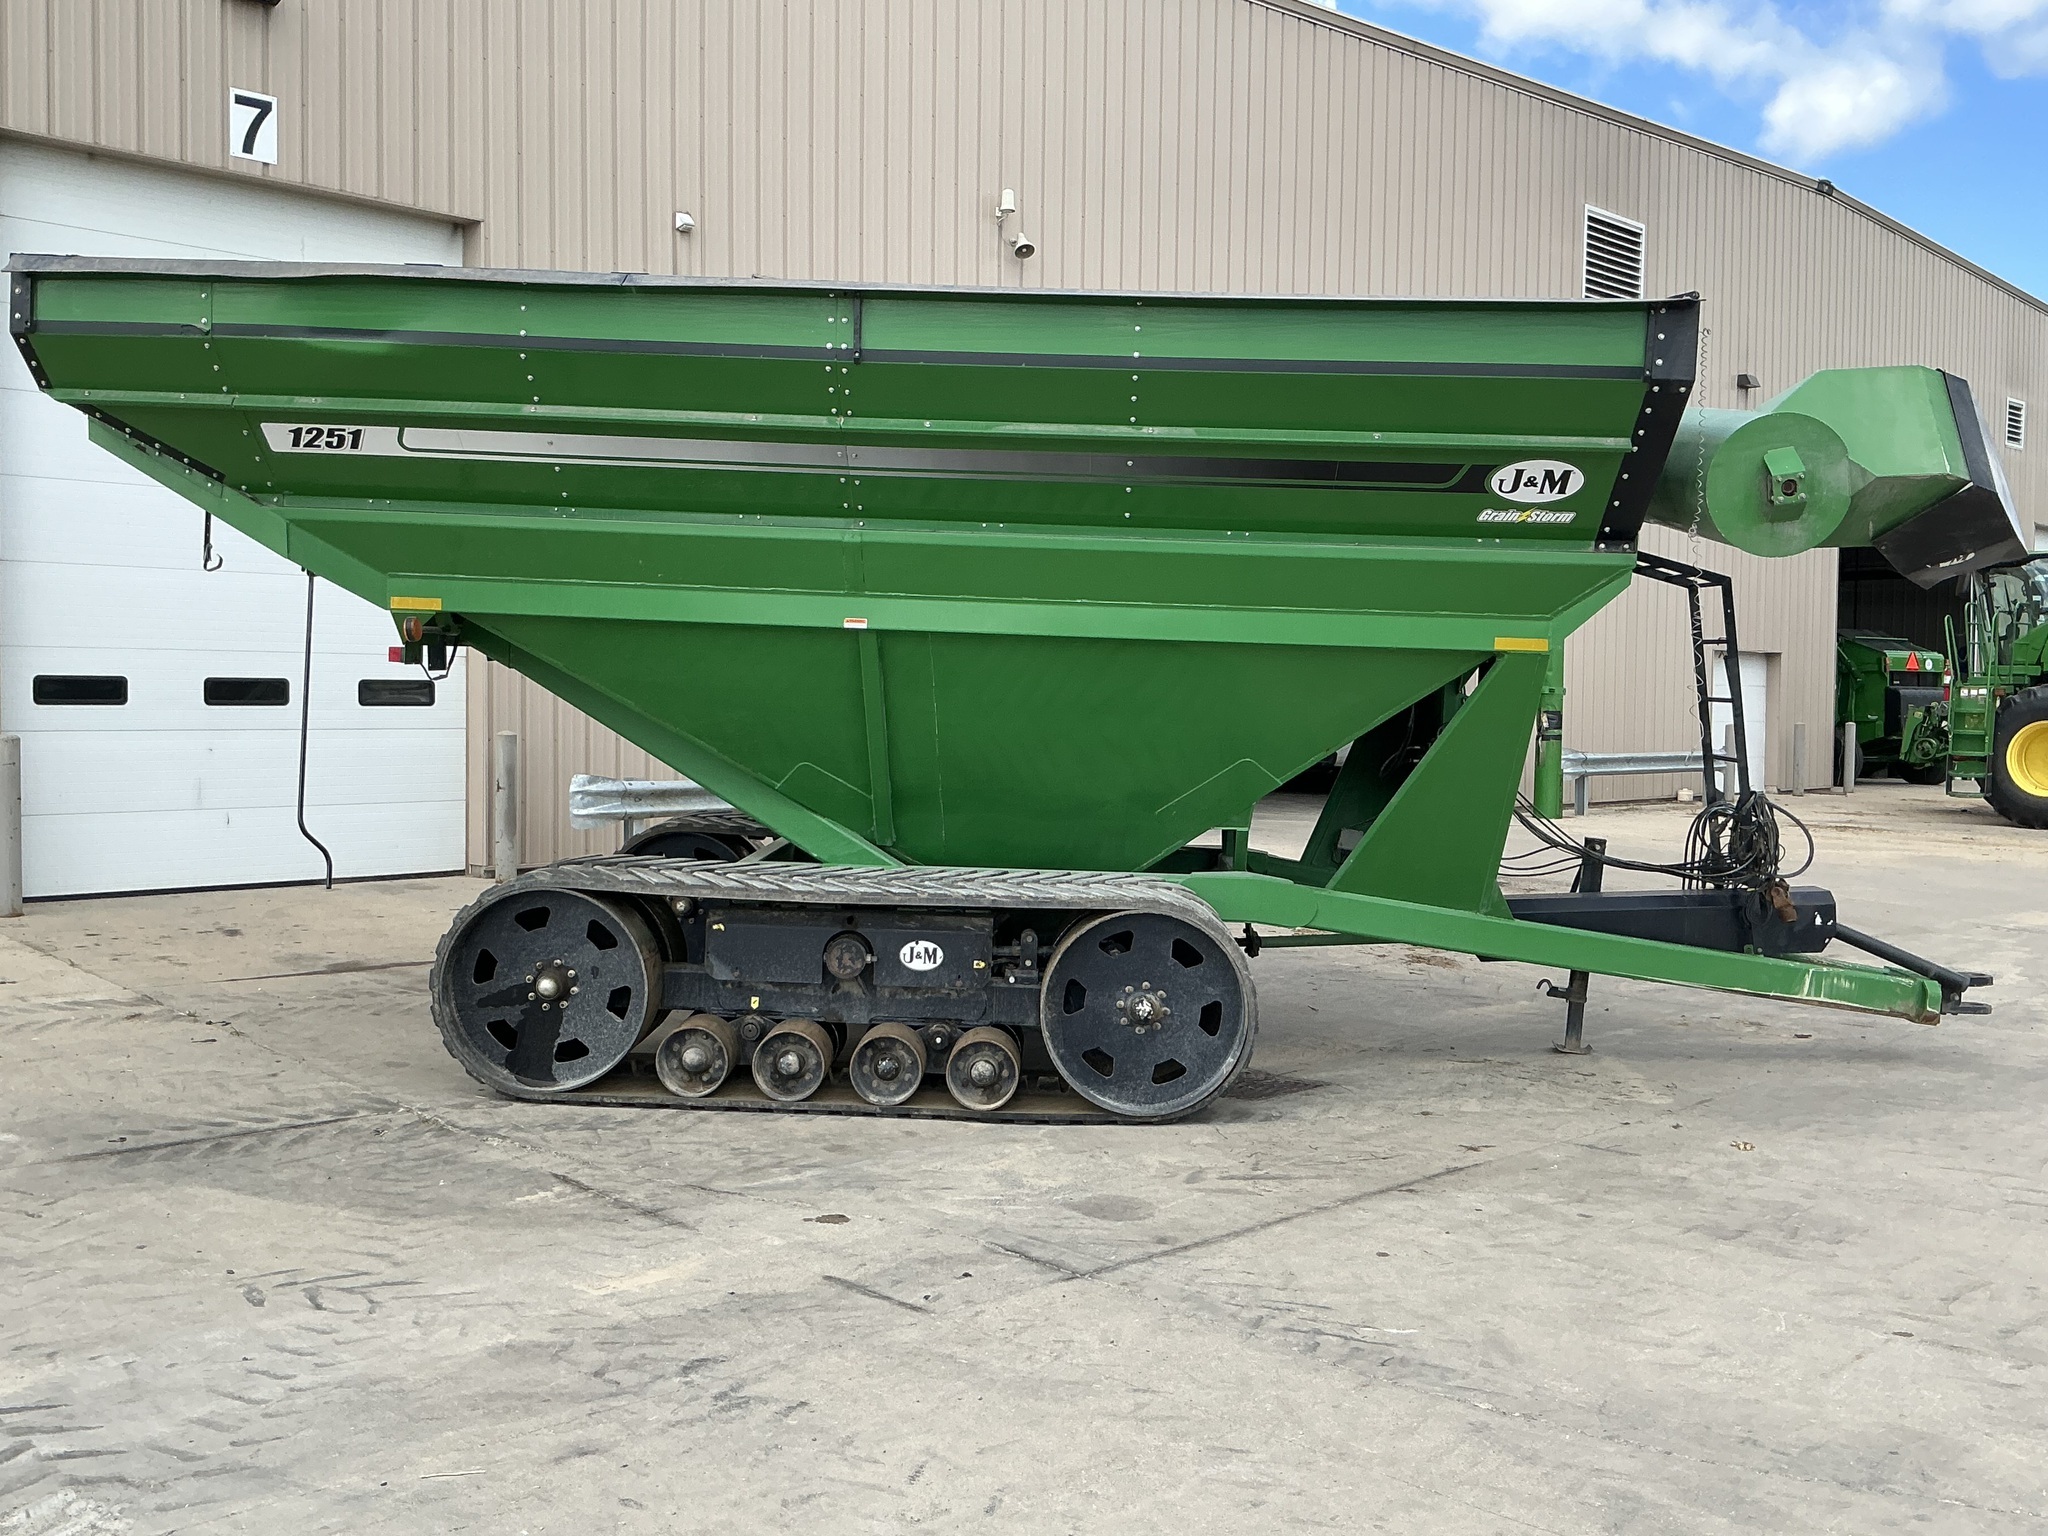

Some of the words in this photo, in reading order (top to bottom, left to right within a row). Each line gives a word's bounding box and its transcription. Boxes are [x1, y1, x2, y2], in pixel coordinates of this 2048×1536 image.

[234, 93, 273, 155] 7
[288, 427, 363, 450] 1251
[1498, 468, 1574, 495] J&M
[1478, 509, 1523, 522] Grain
[1528, 510, 1576, 523] Storm
[902, 946, 938, 965] J&M
